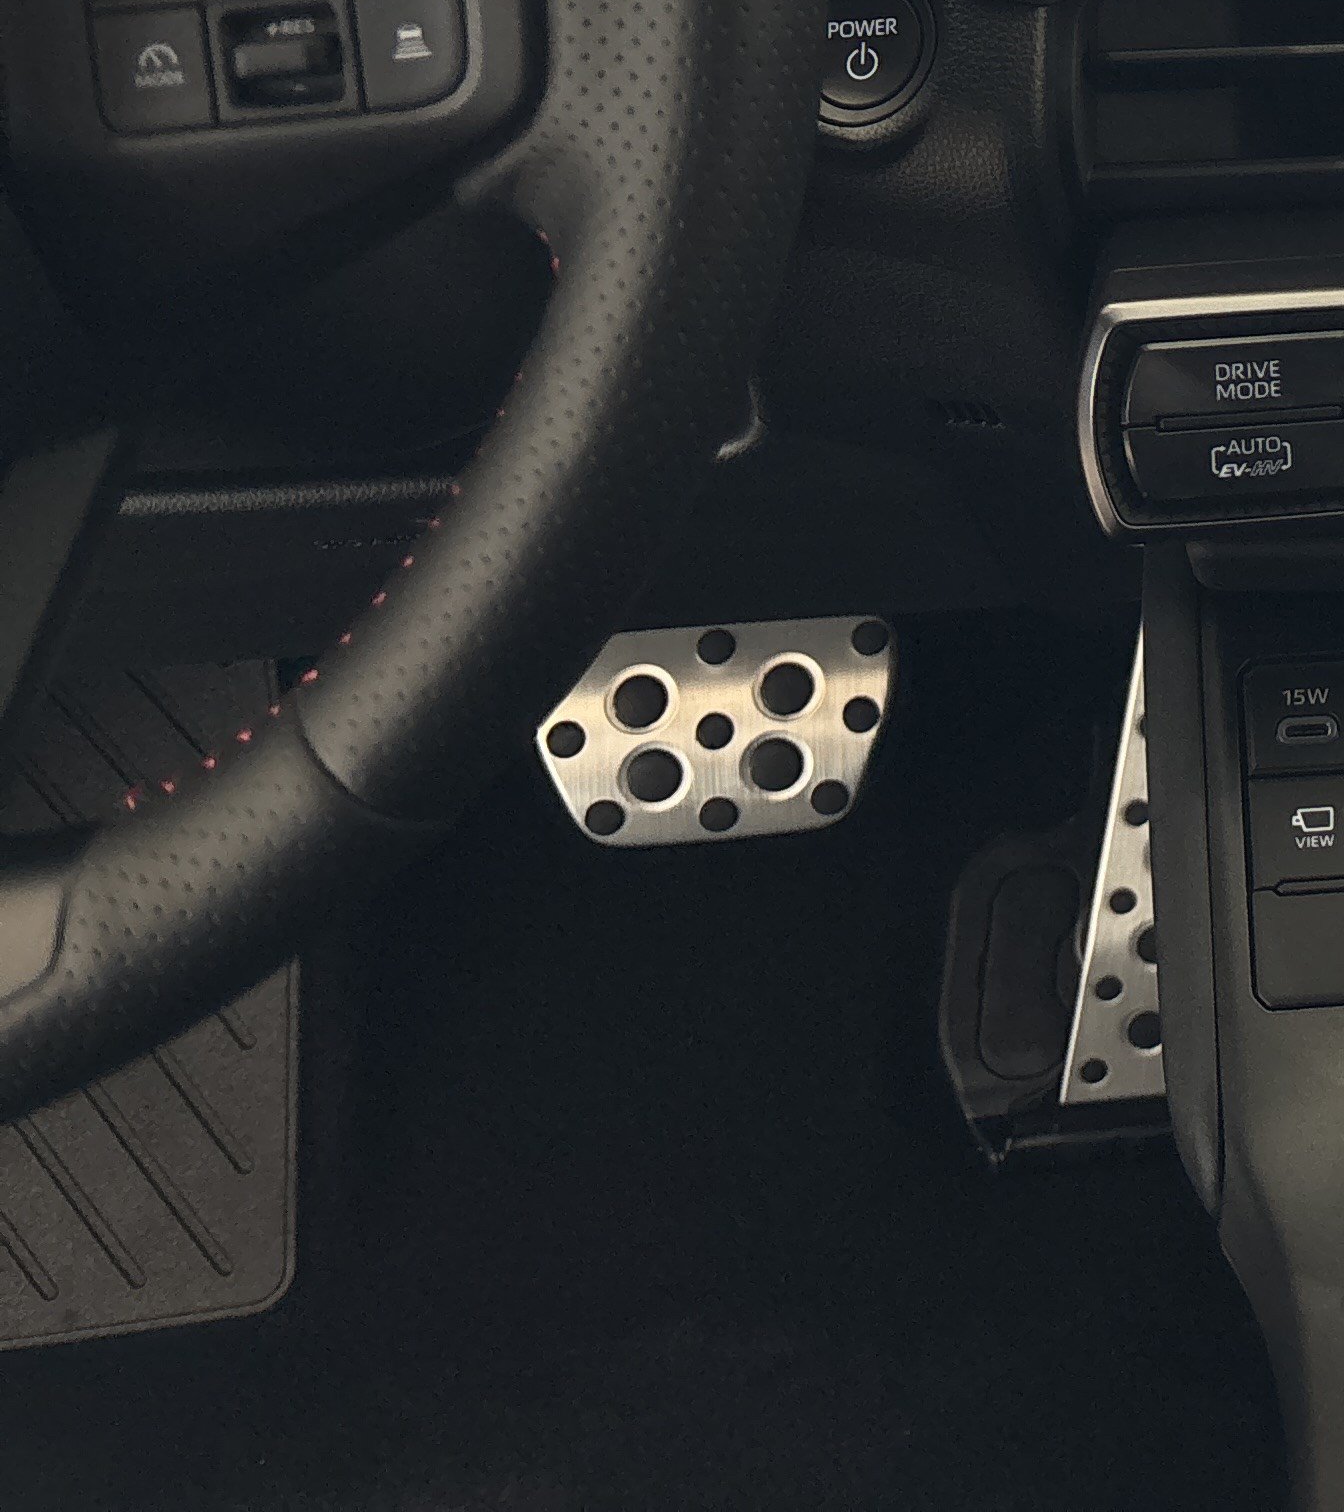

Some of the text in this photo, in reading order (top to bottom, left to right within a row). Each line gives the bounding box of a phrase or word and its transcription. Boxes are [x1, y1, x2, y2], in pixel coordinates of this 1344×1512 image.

[827, 18, 898, 39] POWER
[1215, 360, 1281, 382] DRIVE
[1215, 381, 1282, 401] MODE
[1226, 437, 1282, 455] AUTO
[1282, 688, 1329, 706] 15W
[1295, 835, 1335, 848] VIEW
